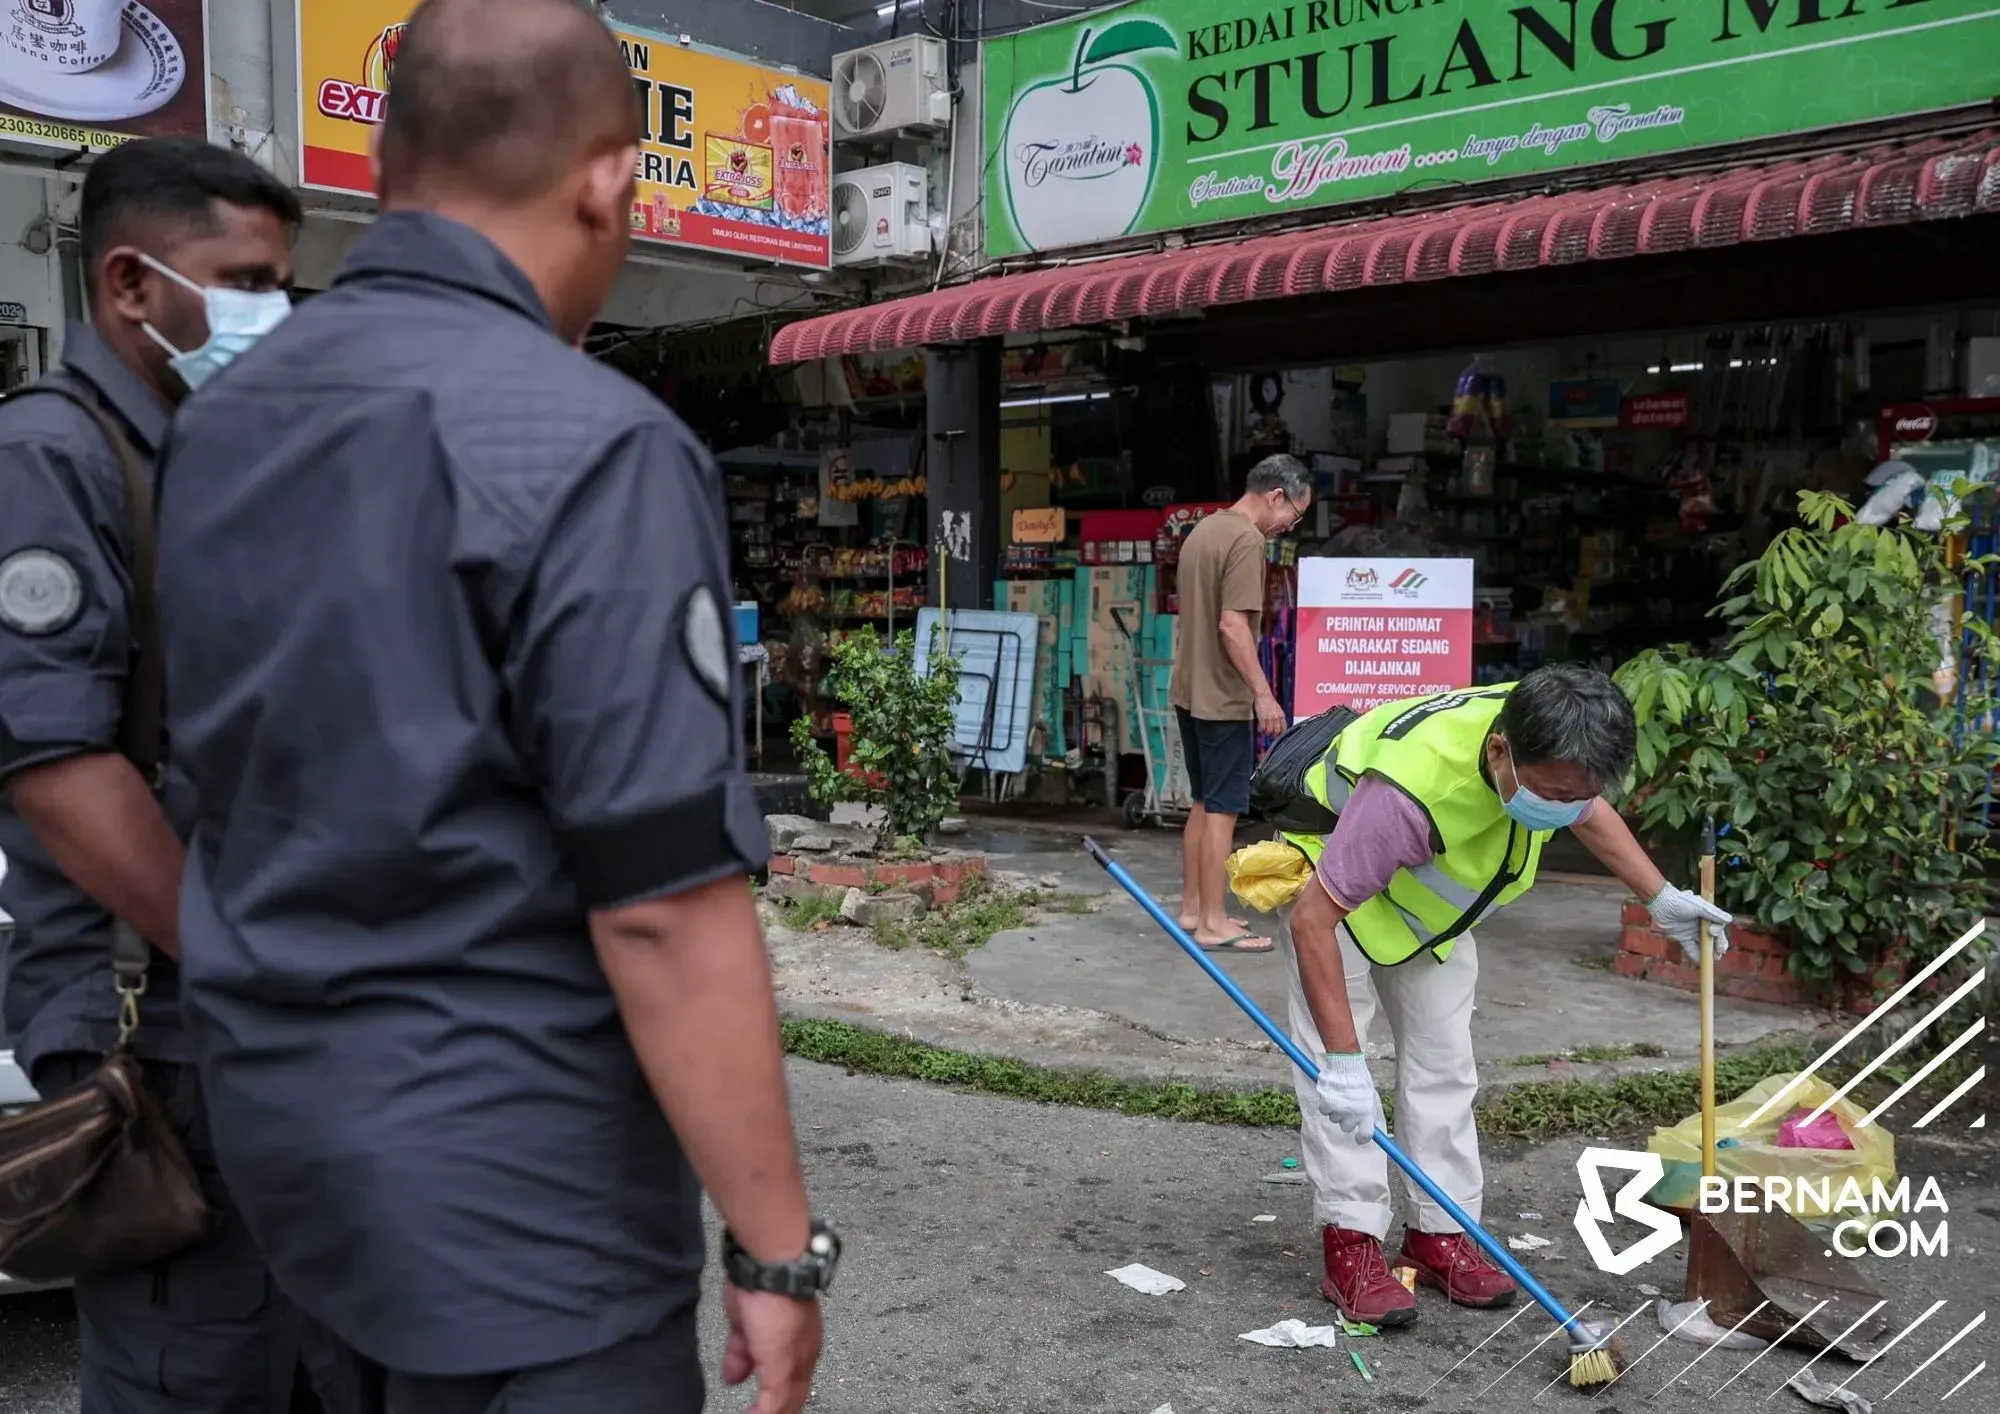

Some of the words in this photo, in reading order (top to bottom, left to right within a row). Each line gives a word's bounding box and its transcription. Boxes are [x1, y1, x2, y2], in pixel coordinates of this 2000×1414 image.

[1187, 10, 1295, 61] KEDAI
[58, 54, 106, 65] Coffee
[1186, 0, 1677, 145] STULANG
[1190, 174, 1262, 206] Sentiasa
[1265, 137, 1409, 201] Harmoni
[1461, 137, 1519, 163] hanya
[1520, 124, 1588, 155] dengan
[1326, 617, 1384, 632] PERINTAH
[1388, 618, 1442, 632] KHIDMAT
[1318, 638, 1398, 653] MASYARAKAT
[1401, 639, 1449, 655] SEDANG
[1345, 661, 1420, 676] DIJALANKAN
[1316, 683, 1375, 694] COMMUNITY
[1377, 684, 1416, 695] SERVICE
[1417, 684, 1450, 695] ORDER
[1352, 698, 1364, 709] IN
